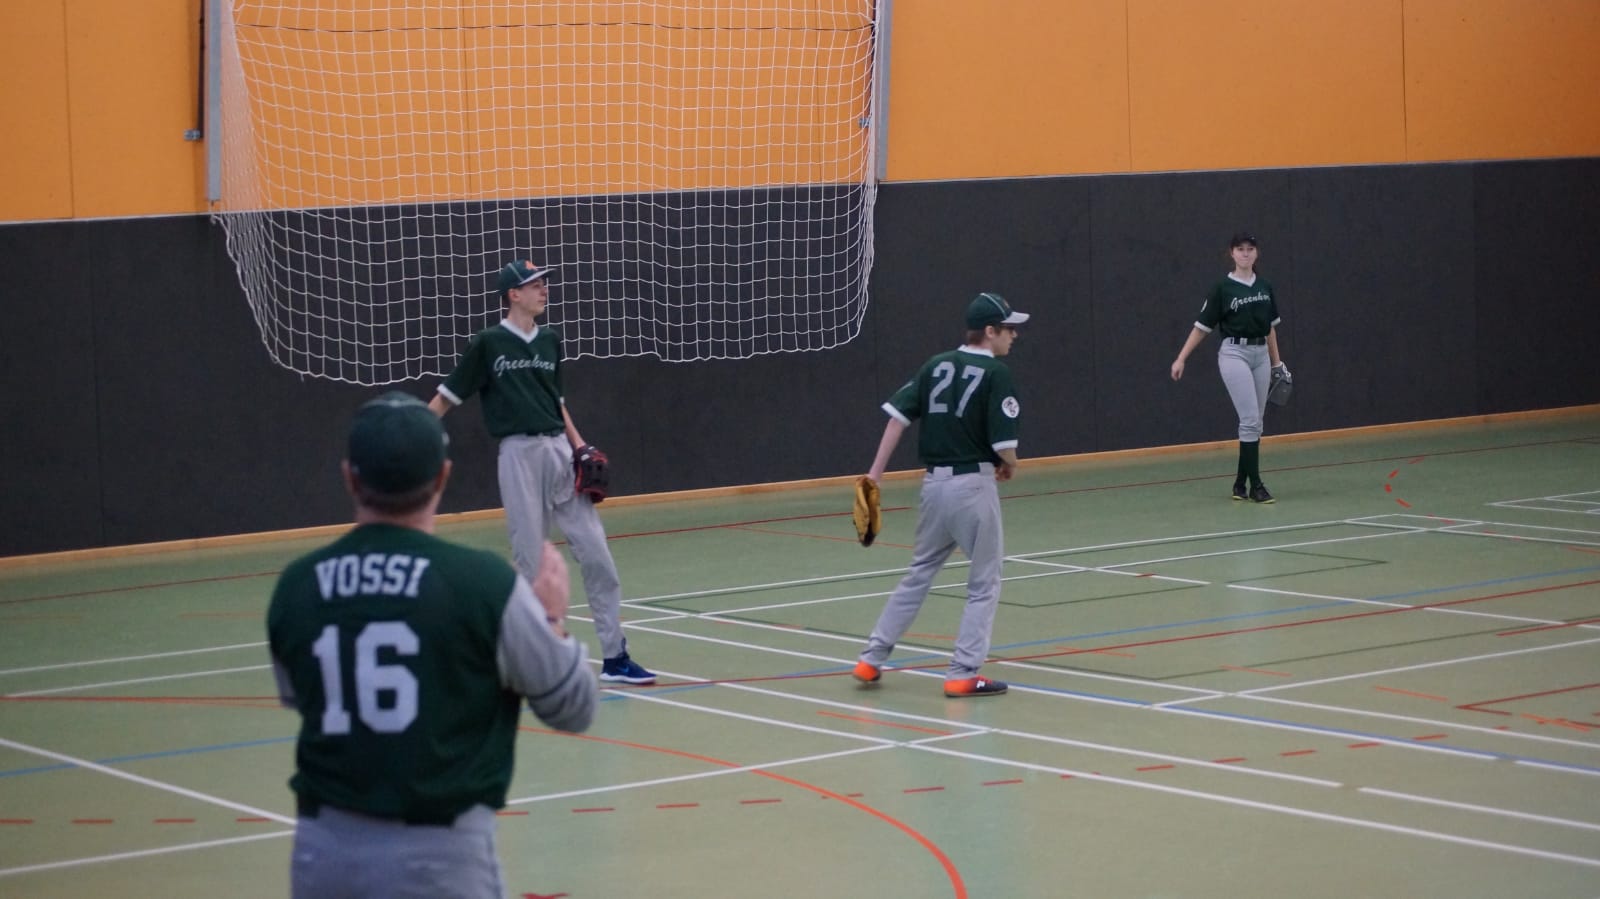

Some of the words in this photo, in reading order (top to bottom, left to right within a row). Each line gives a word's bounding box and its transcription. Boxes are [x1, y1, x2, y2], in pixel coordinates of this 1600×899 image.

[928, 361, 985, 418] 27
[315, 553, 430, 600] VOSSI
[312, 620, 419, 735] 16
